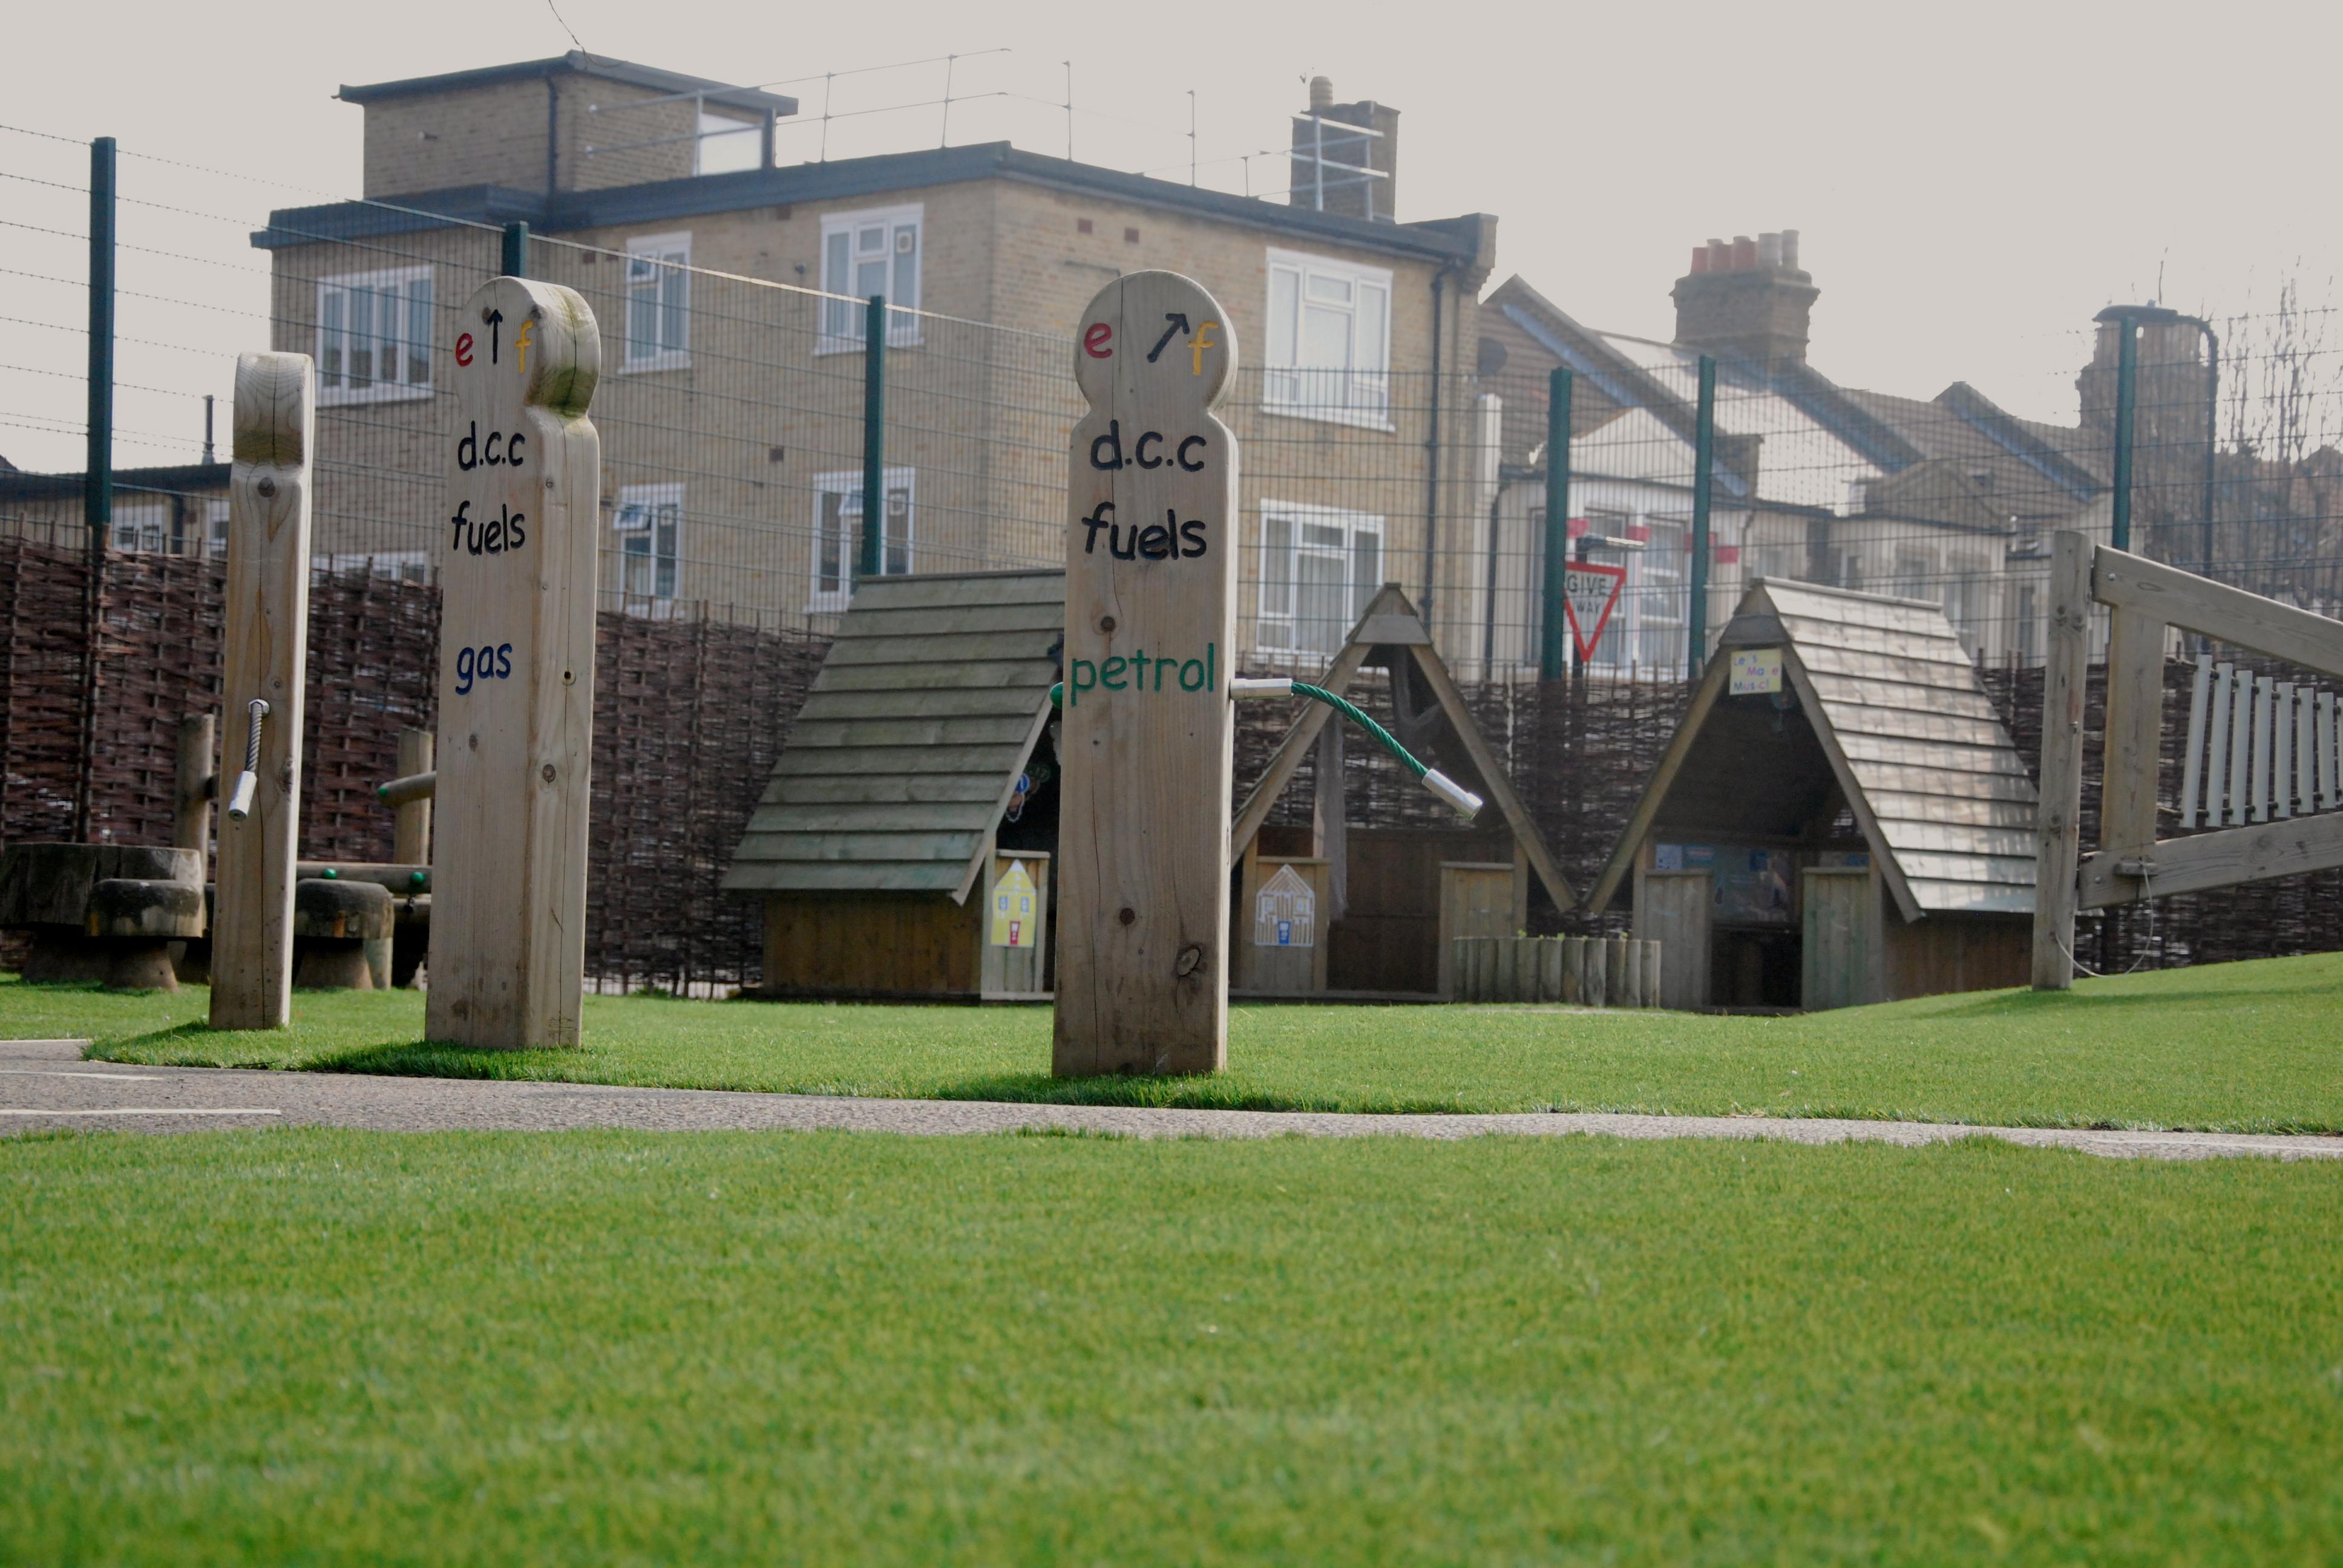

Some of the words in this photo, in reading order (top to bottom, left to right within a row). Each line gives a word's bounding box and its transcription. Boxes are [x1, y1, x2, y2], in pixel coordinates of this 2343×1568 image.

[455, 333, 474, 367] e
[514, 320, 533, 373] f
[1083, 322, 1113, 359] e
[1188, 321, 1219, 374] f
[457, 420, 526, 471] d.c.c
[1090, 419, 1207, 472] d.c.c
[451, 500, 526, 556] fuels
[1081, 501, 1207, 560] fuels
[1567, 575, 1607, 595] GIVE
[1577, 601, 1600, 613] WAY
[455, 643, 513, 696] gas
[1070, 642, 1214, 707] petrol
